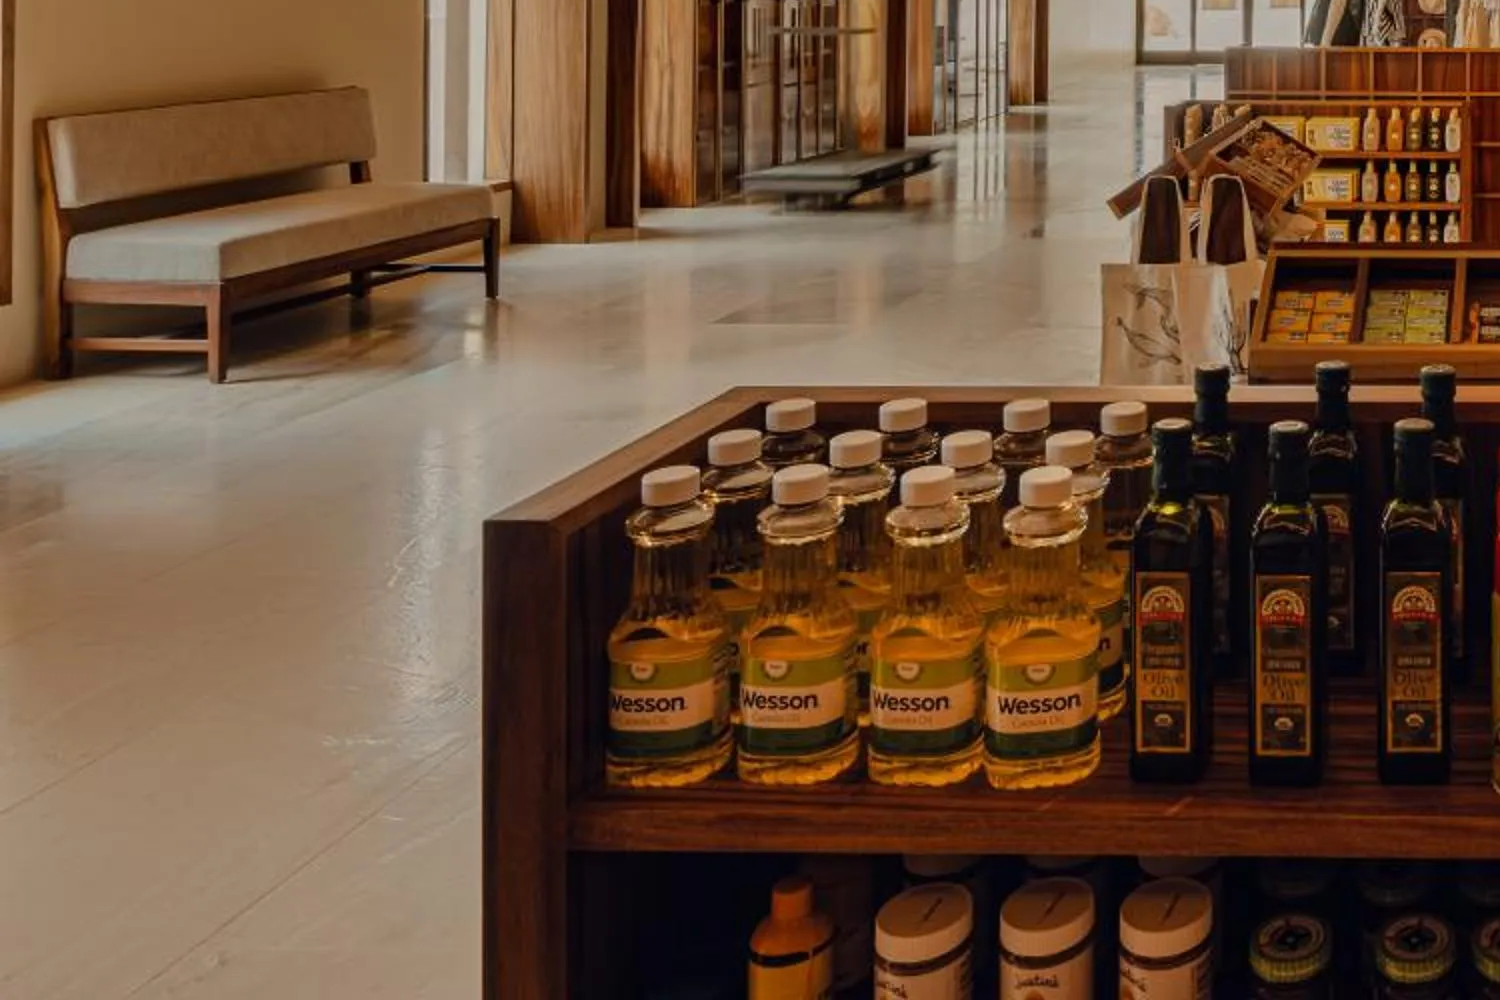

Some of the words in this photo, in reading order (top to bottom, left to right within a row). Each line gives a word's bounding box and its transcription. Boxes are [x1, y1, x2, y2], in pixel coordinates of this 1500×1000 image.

[612, 696, 686, 713] Wesson
[742, 689, 818, 711] Wesson
[874, 692, 949, 712] Wesson
[998, 694, 1081, 715] Wesson
